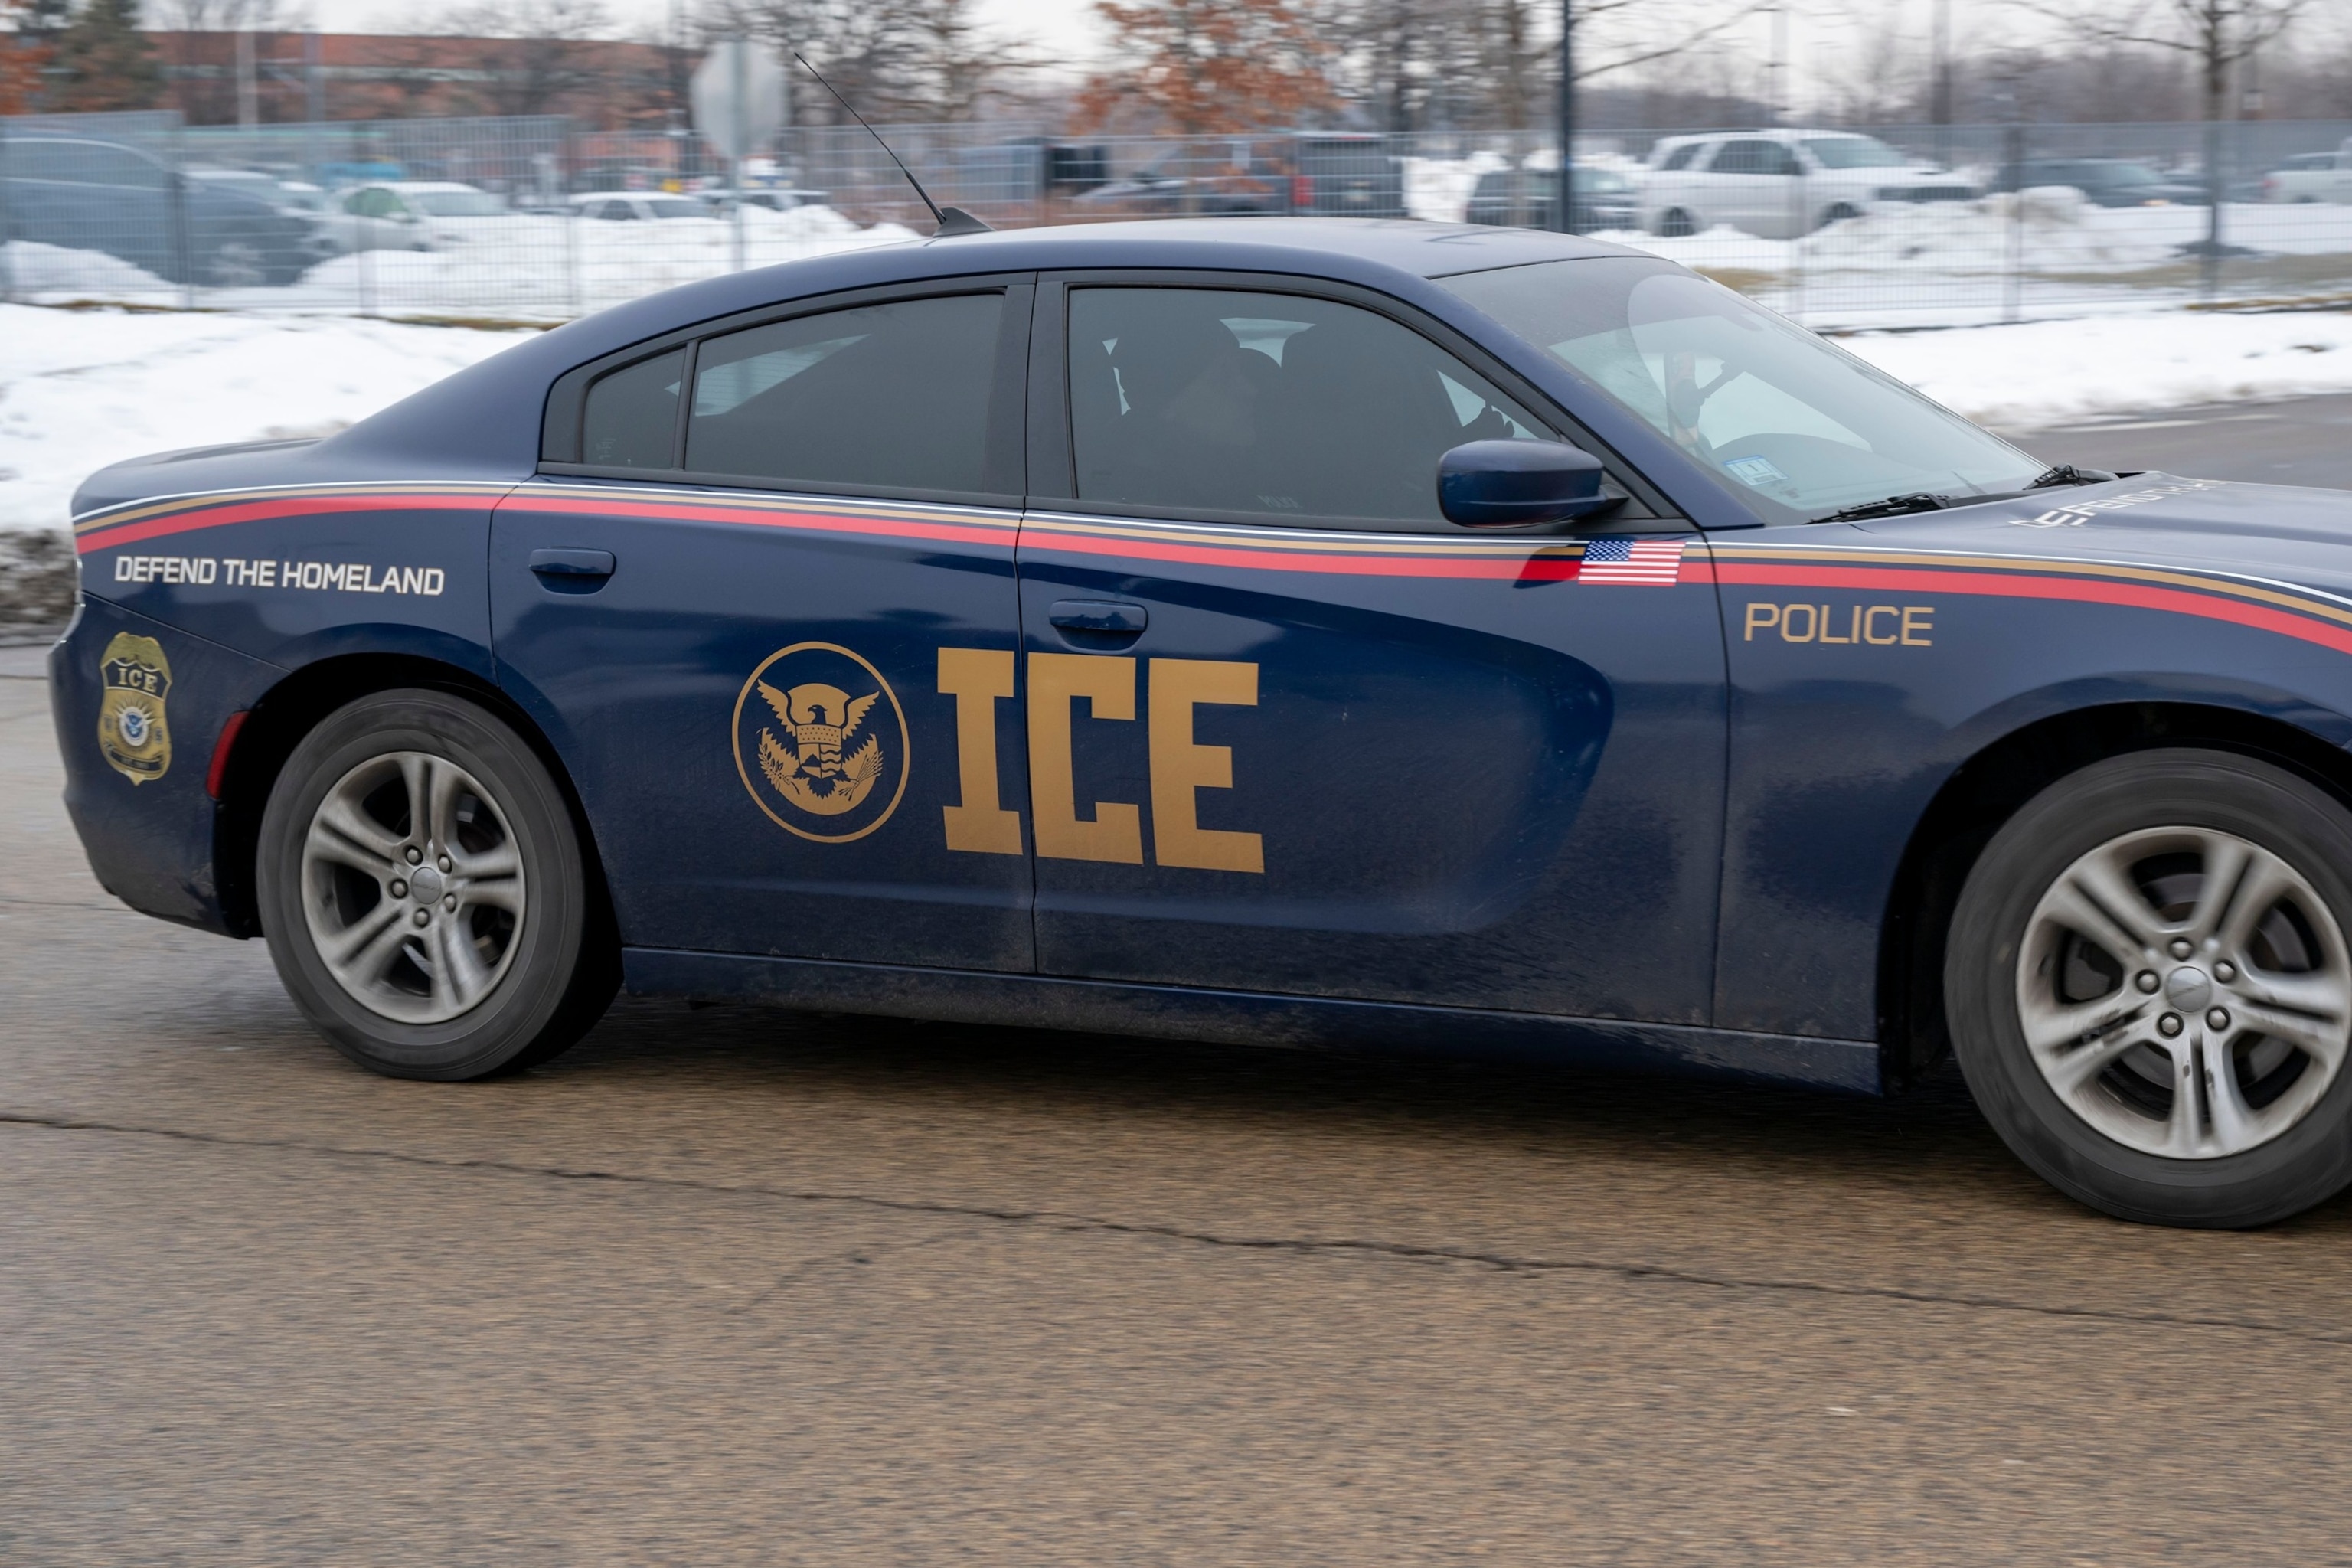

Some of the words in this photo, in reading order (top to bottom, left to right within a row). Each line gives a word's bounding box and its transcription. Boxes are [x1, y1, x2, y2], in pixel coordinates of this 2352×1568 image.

[114, 556, 217, 584] DEFEND
[222, 560, 276, 587] THE
[281, 561, 445, 596] HOMELAND
[1743, 603, 1935, 646] POLICE
[117, 667, 158, 692] ICE
[937, 647, 1264, 874] ICE
